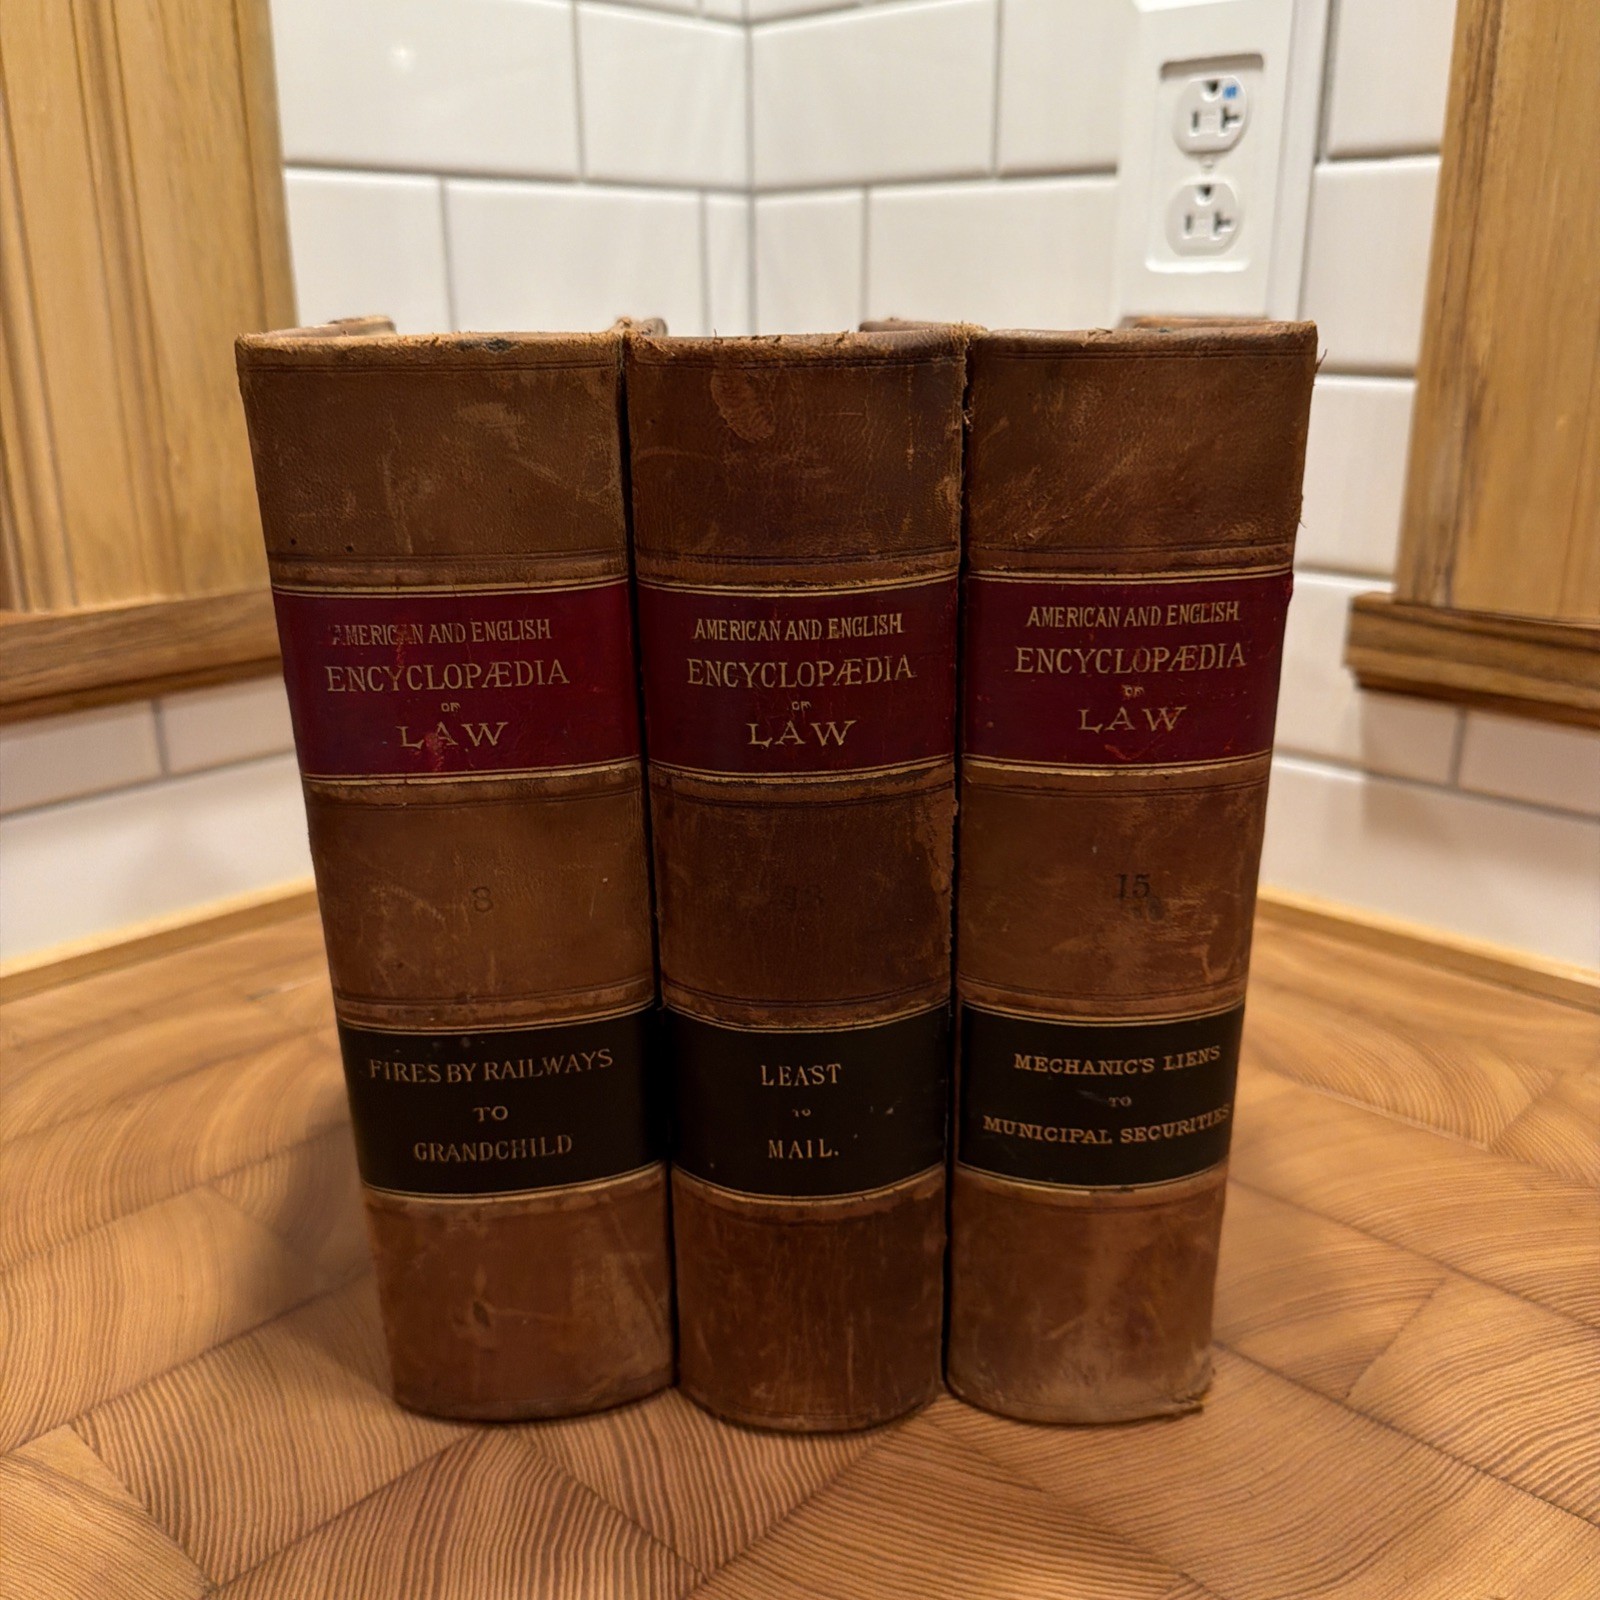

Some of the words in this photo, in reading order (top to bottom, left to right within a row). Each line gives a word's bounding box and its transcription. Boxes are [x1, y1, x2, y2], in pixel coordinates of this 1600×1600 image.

[693, 618, 781, 641] AMERICAN
[784, 618, 822, 641] AND
[827, 613, 904, 638] ENGLISH
[1026, 606, 1121, 628] AMERICAN
[1123, 605, 1162, 628] AND
[1165, 601, 1240, 626] ENGLISH
[428, 622, 466, 644] AND
[471, 618, 552, 643] ENGLISH
[687, 654, 918, 689] ENCYCLOPÆDIA
[1014, 642, 1247, 674] ENCYCLOPÆDIA
[324, 658, 570, 692] ENCYCLOPÆDIA
[746, 720, 857, 748] LAW
[1077, 706, 1188, 734] LAW
[396, 721, 509, 750] LAW
[1111, 873, 1151, 901] 15
[369, 1059, 442, 1084] FIRES
[446, 1062, 477, 1084] BY
[483, 1048, 614, 1082] RAILWAYS
[760, 1063, 842, 1086] LEAST
[1013, 1053, 1156, 1076] MECHANIC'S
[1163, 1045, 1221, 1072] LIENS
[473, 1105, 509, 1122] TO
[1108, 1096, 1133, 1108] TO
[983, 1115, 1113, 1145] MUNICIPAL
[1120, 1103, 1232, 1144] SECURITIES
[413, 1134, 574, 1163] GRANDCHILD
[768, 1138, 840, 1159] MAIL.
